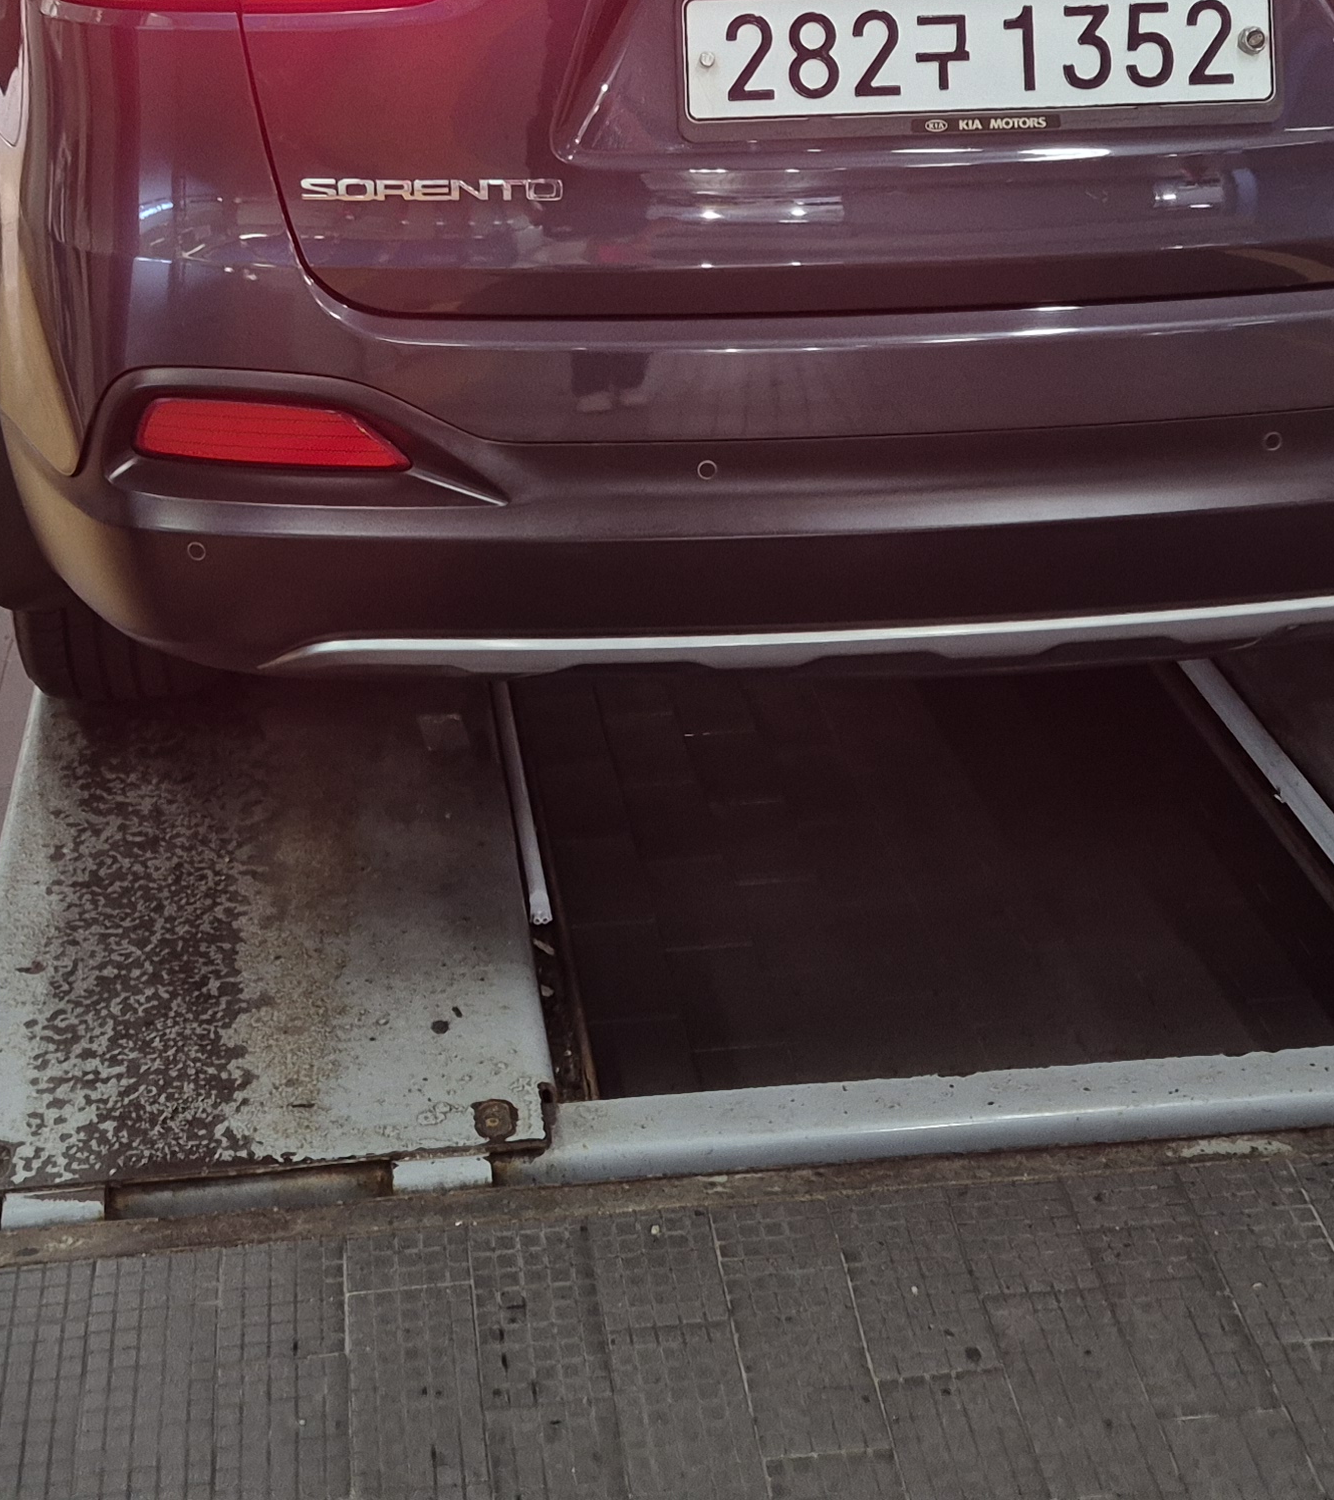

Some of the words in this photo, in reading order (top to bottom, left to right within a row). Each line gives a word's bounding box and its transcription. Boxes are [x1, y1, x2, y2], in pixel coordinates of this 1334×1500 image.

[726, 9, 970, 102] 282구
[1003, 0, 1235, 92] 1352
[959, 119, 983, 131] KIA
[990, 116, 1047, 130] MOTORS
[300, 178, 564, 202] SORENTO
